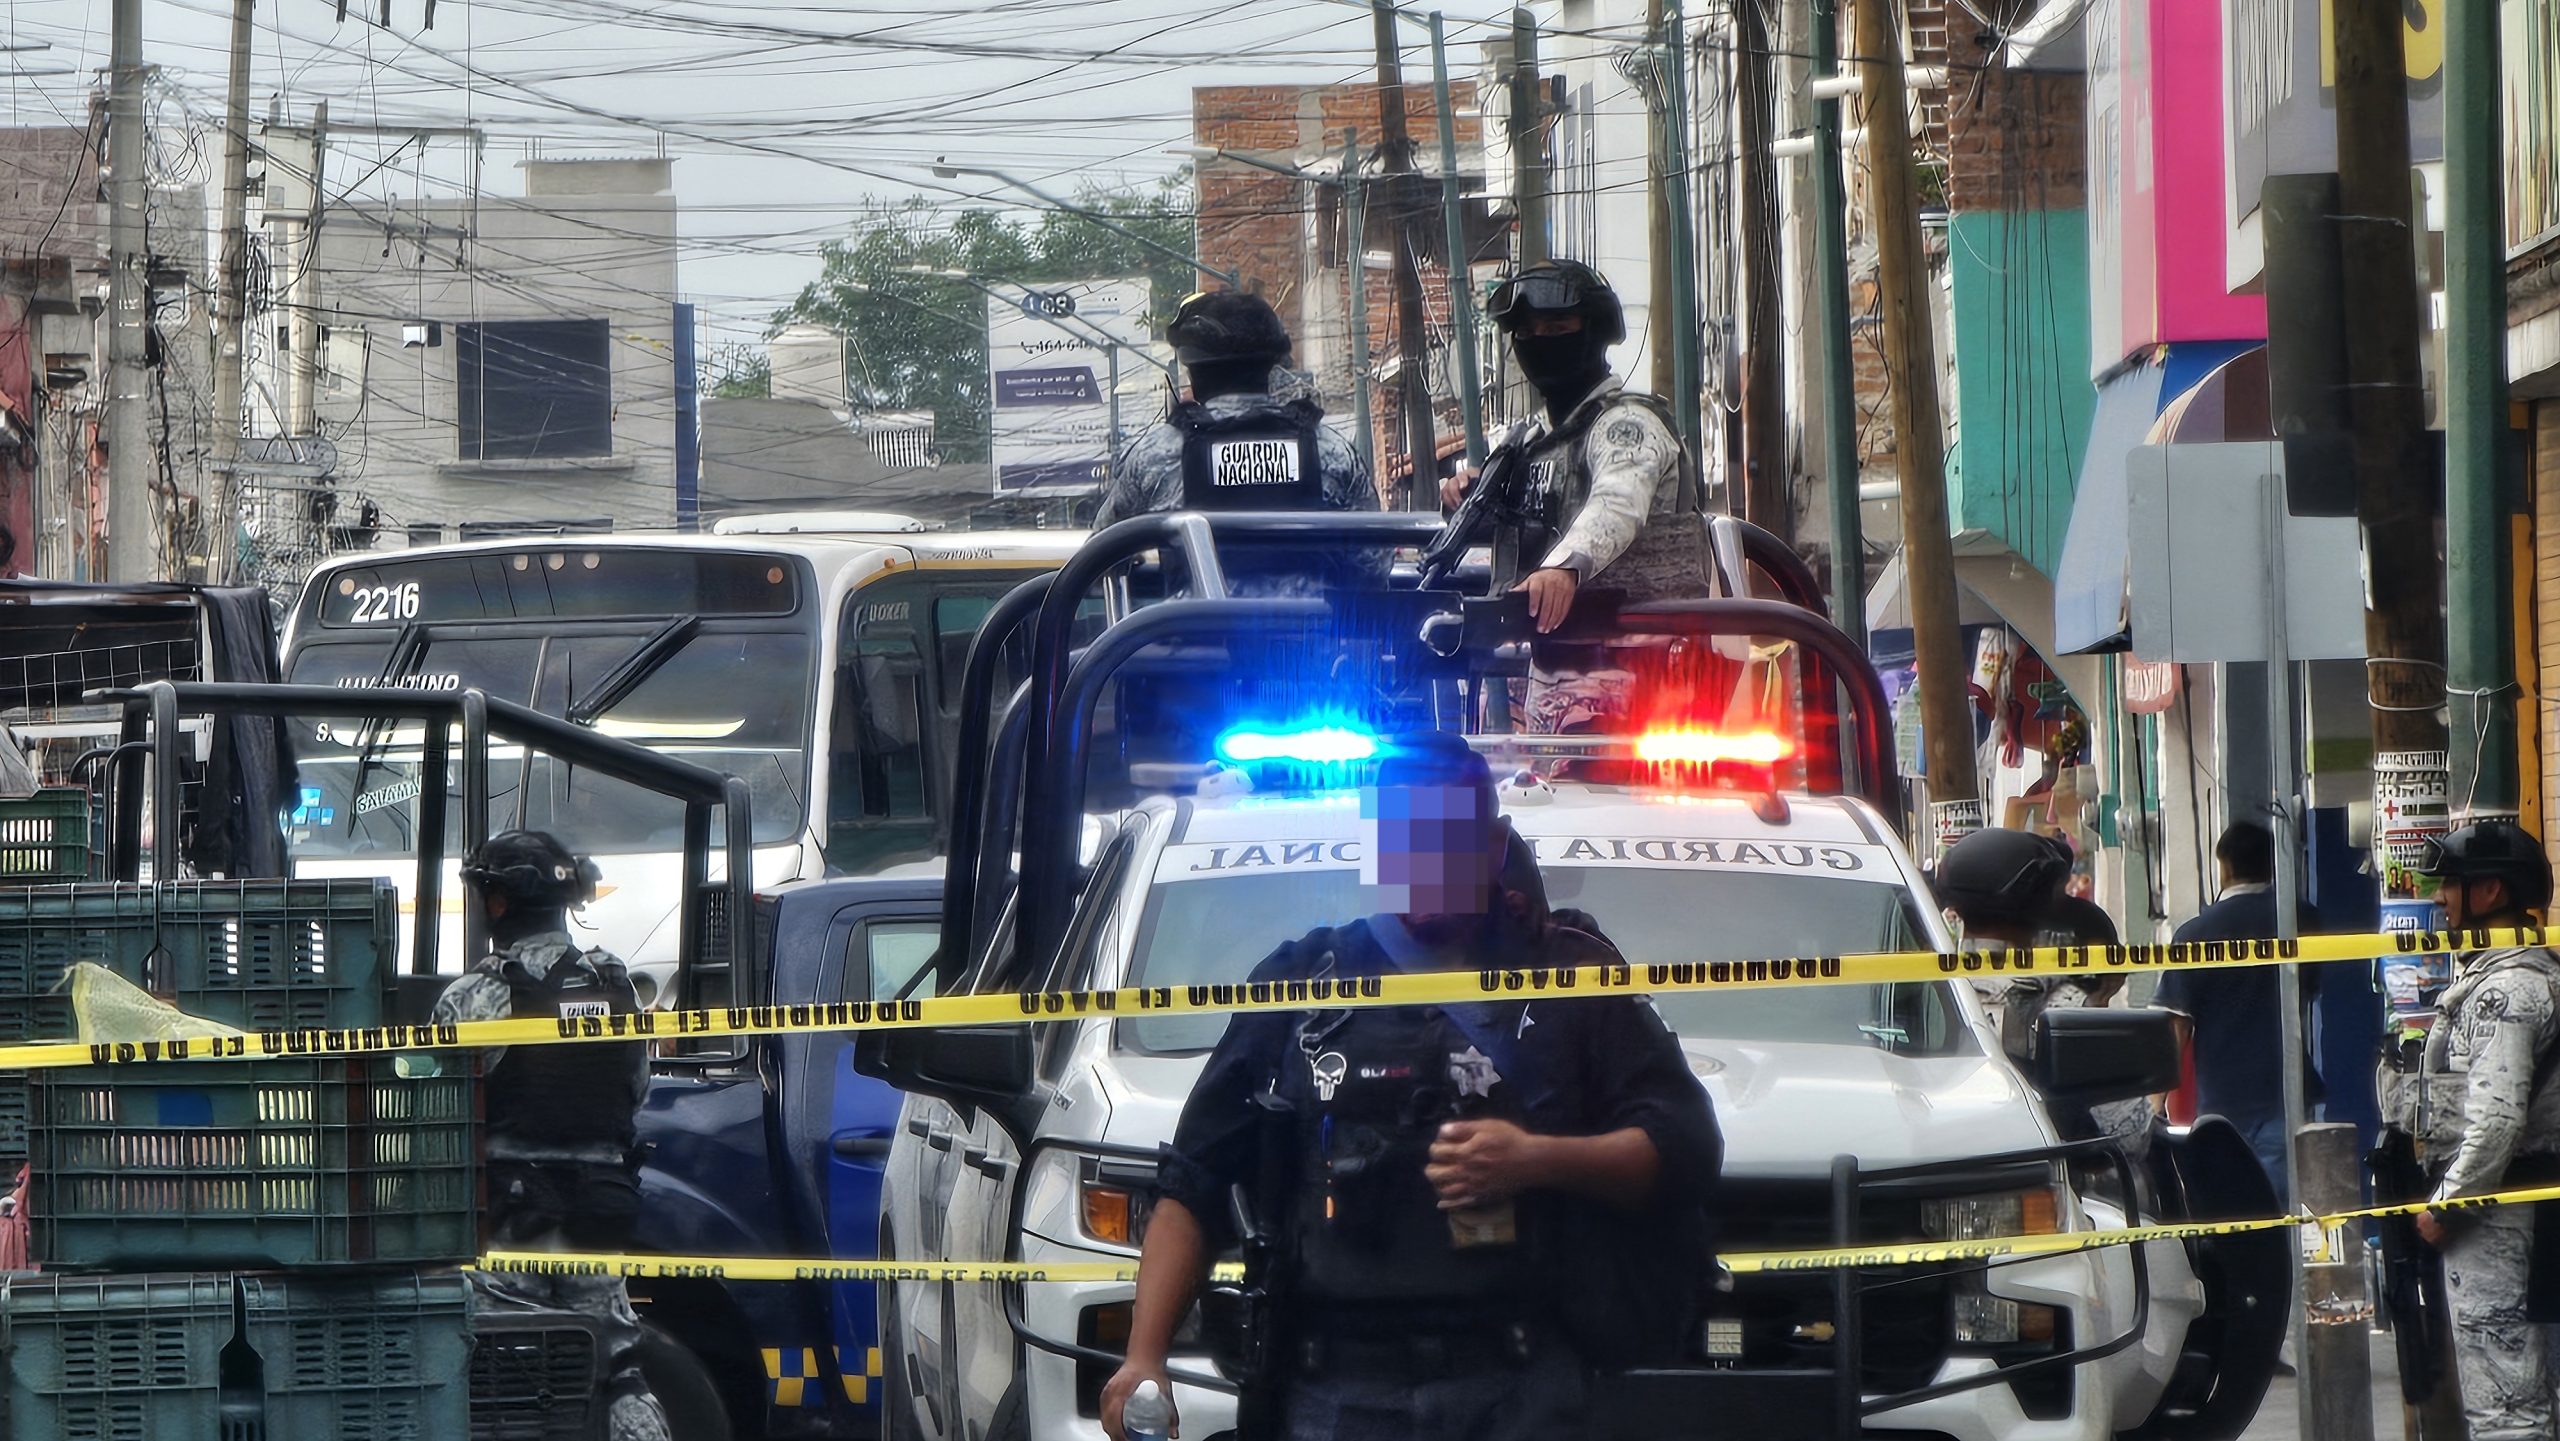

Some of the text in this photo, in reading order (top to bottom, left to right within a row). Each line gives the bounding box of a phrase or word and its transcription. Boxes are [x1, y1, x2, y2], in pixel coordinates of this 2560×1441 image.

[1221, 442, 1288, 464] GUARDIA
[1218, 463, 1294, 486] NACIONAL
[351, 582, 420, 623] 2216
